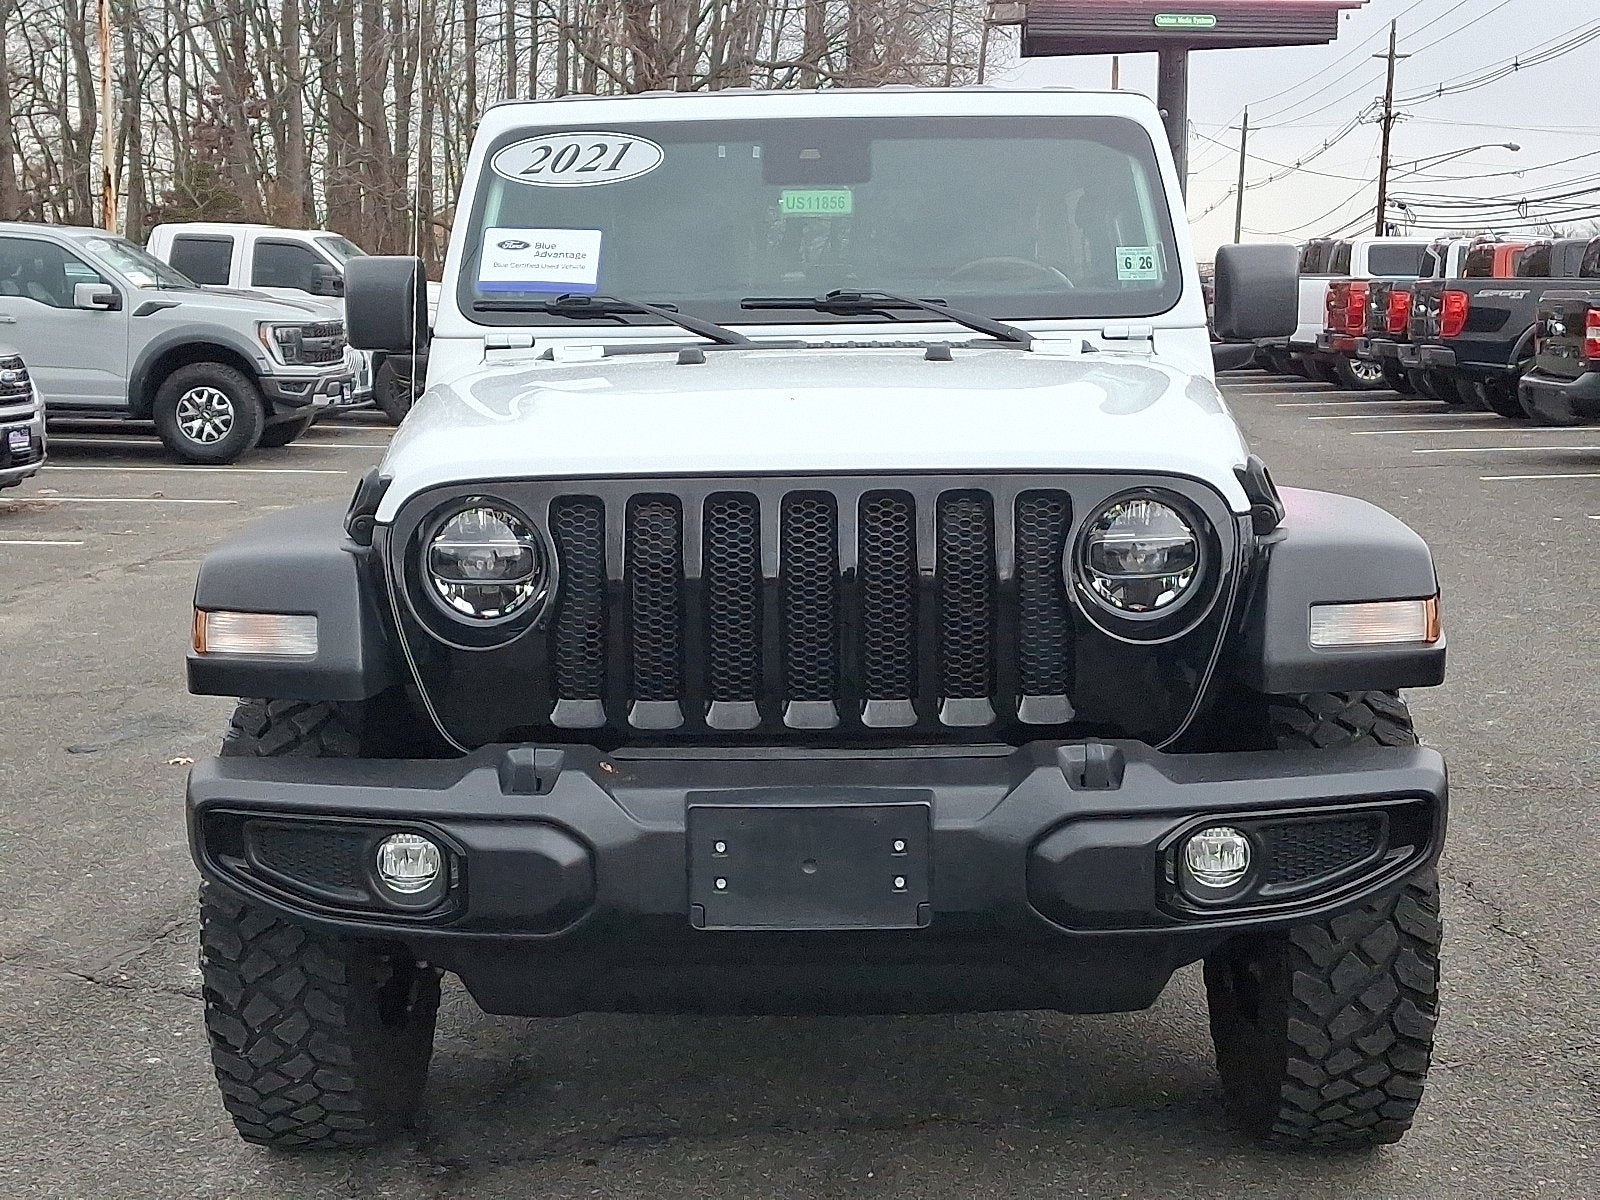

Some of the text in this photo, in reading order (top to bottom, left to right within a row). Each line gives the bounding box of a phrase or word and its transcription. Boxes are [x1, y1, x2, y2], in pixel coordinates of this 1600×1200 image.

[519, 141, 634, 175] 2021
[786, 195, 846, 210] US11856
[500, 240, 528, 249] Ford
[535, 242, 557, 250] Blue
[534, 250, 587, 260] Advantage
[510, 261, 540, 269] Certified
[541, 262, 560, 270] Used
[1125, 256, 1152, 269] 6 26
